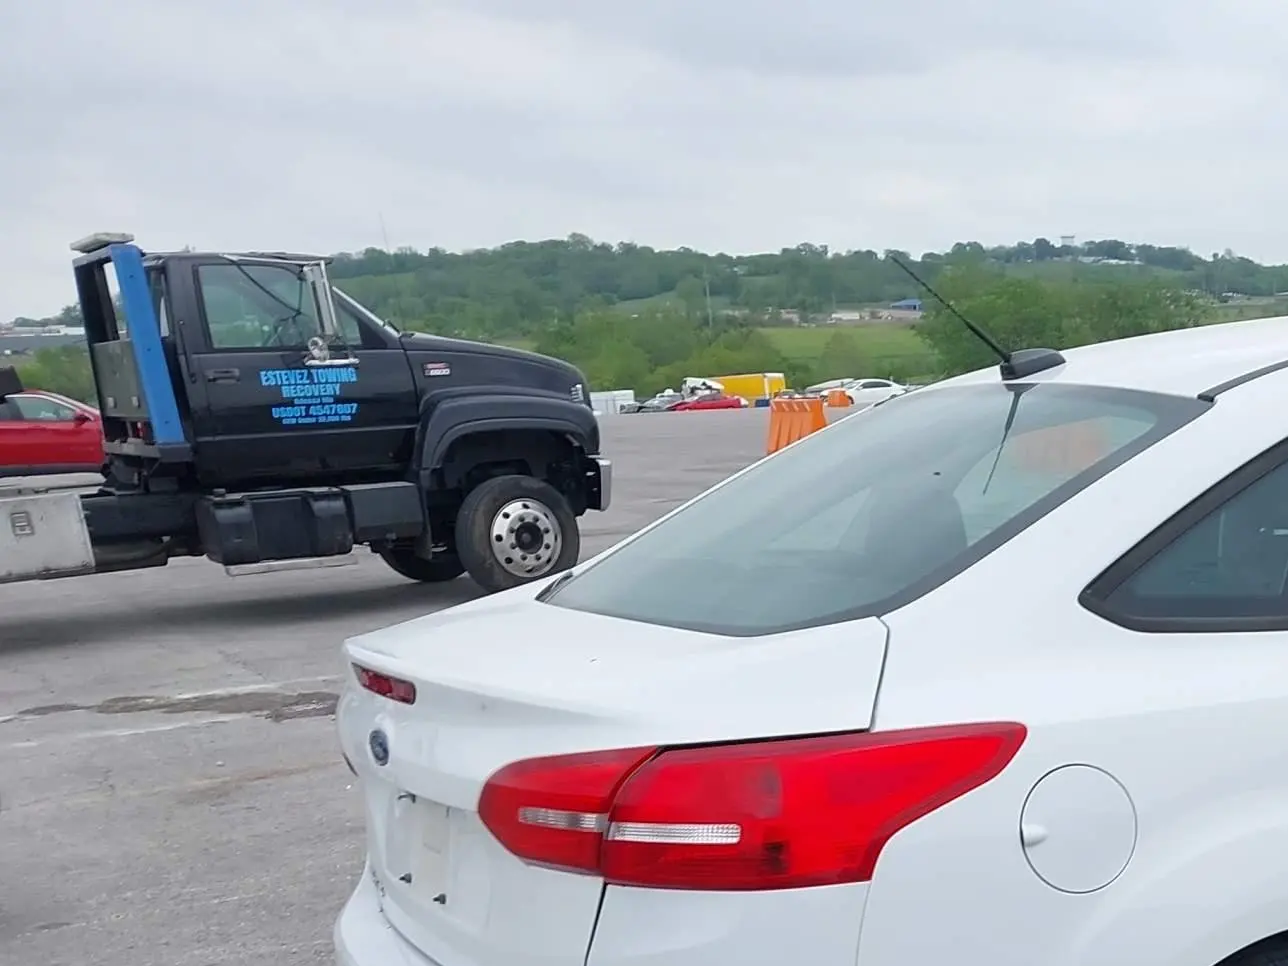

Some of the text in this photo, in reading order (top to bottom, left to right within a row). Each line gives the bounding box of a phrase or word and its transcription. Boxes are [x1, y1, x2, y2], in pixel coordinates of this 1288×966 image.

[260, 367, 358, 386] ESTEVEZ TOWING
[281, 383, 341, 398] RECOVERY
